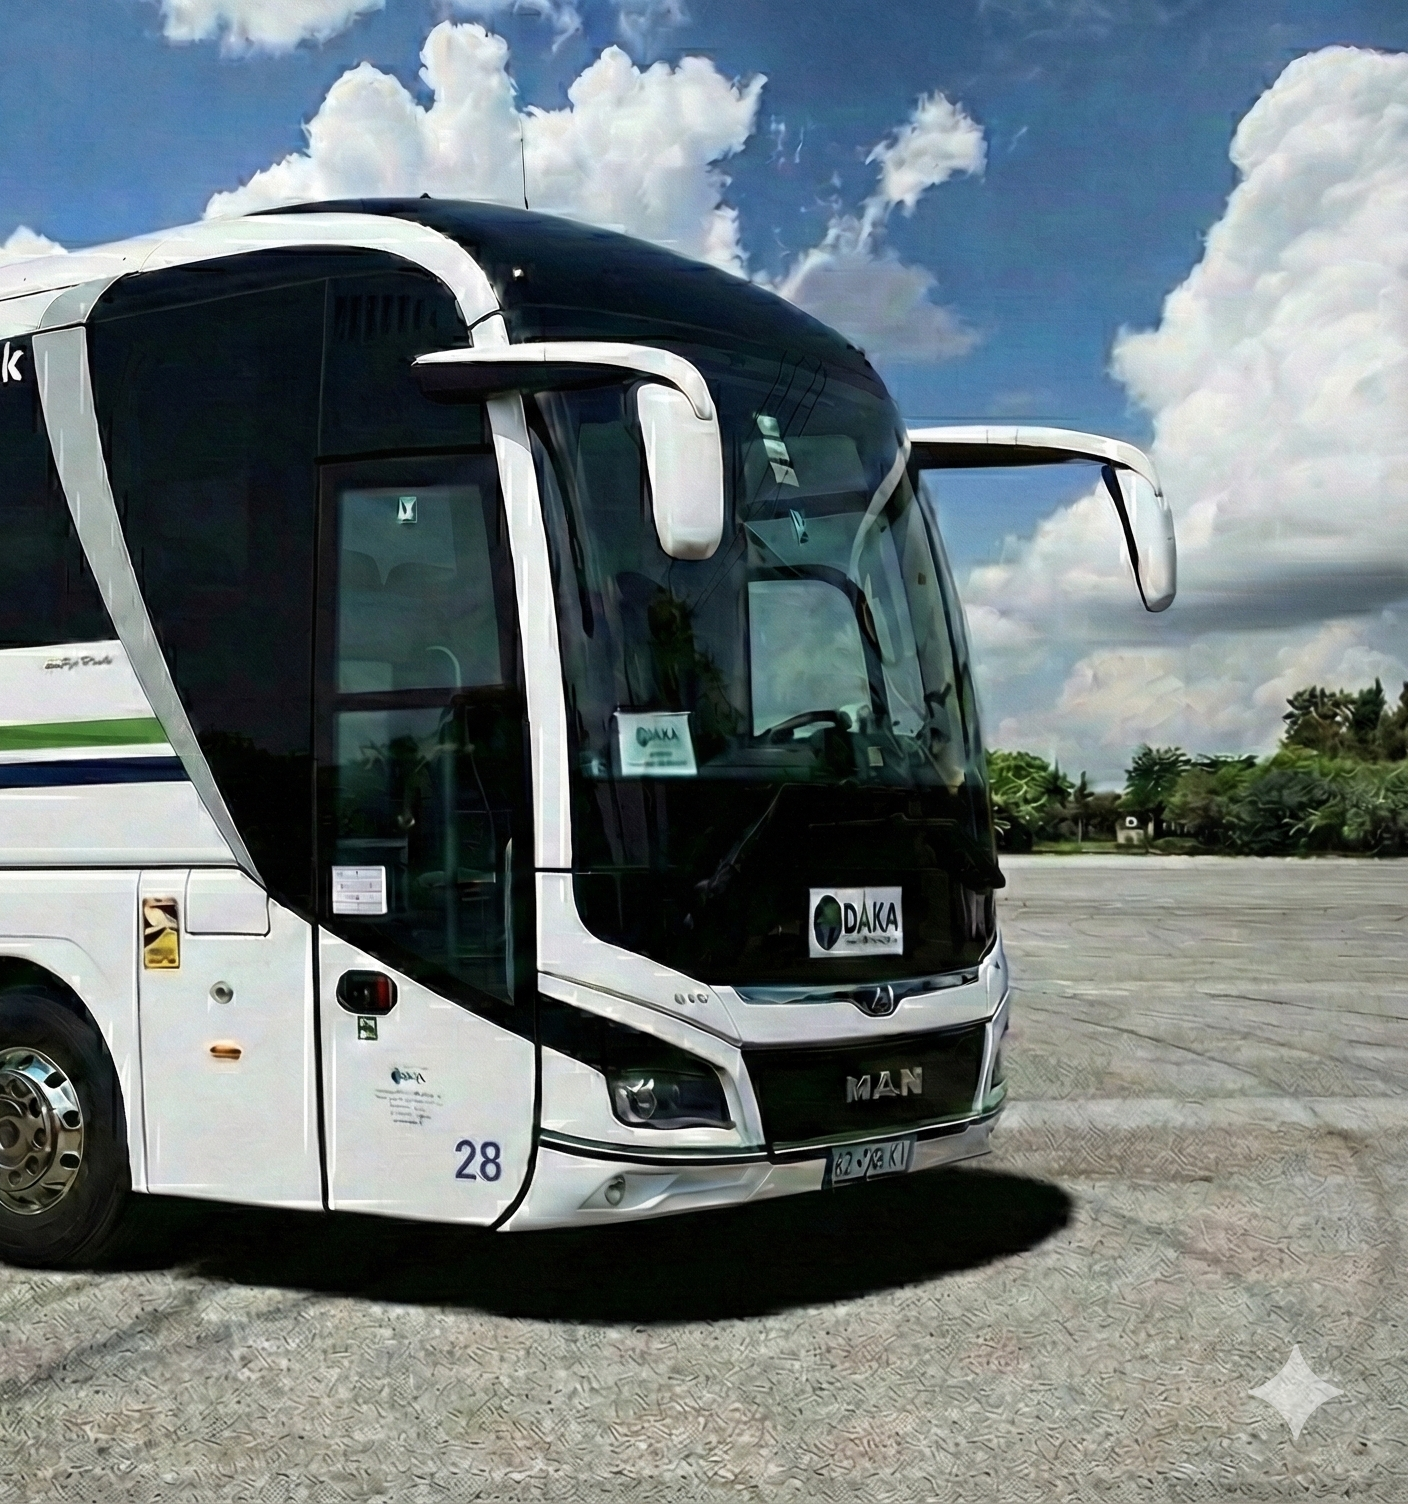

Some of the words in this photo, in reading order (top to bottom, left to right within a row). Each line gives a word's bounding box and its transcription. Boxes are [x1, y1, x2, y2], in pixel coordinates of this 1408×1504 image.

[843, 890, 899, 935] DAKA
[846, 1066, 924, 1103] MAN
[454, 1138, 502, 1182] 28
